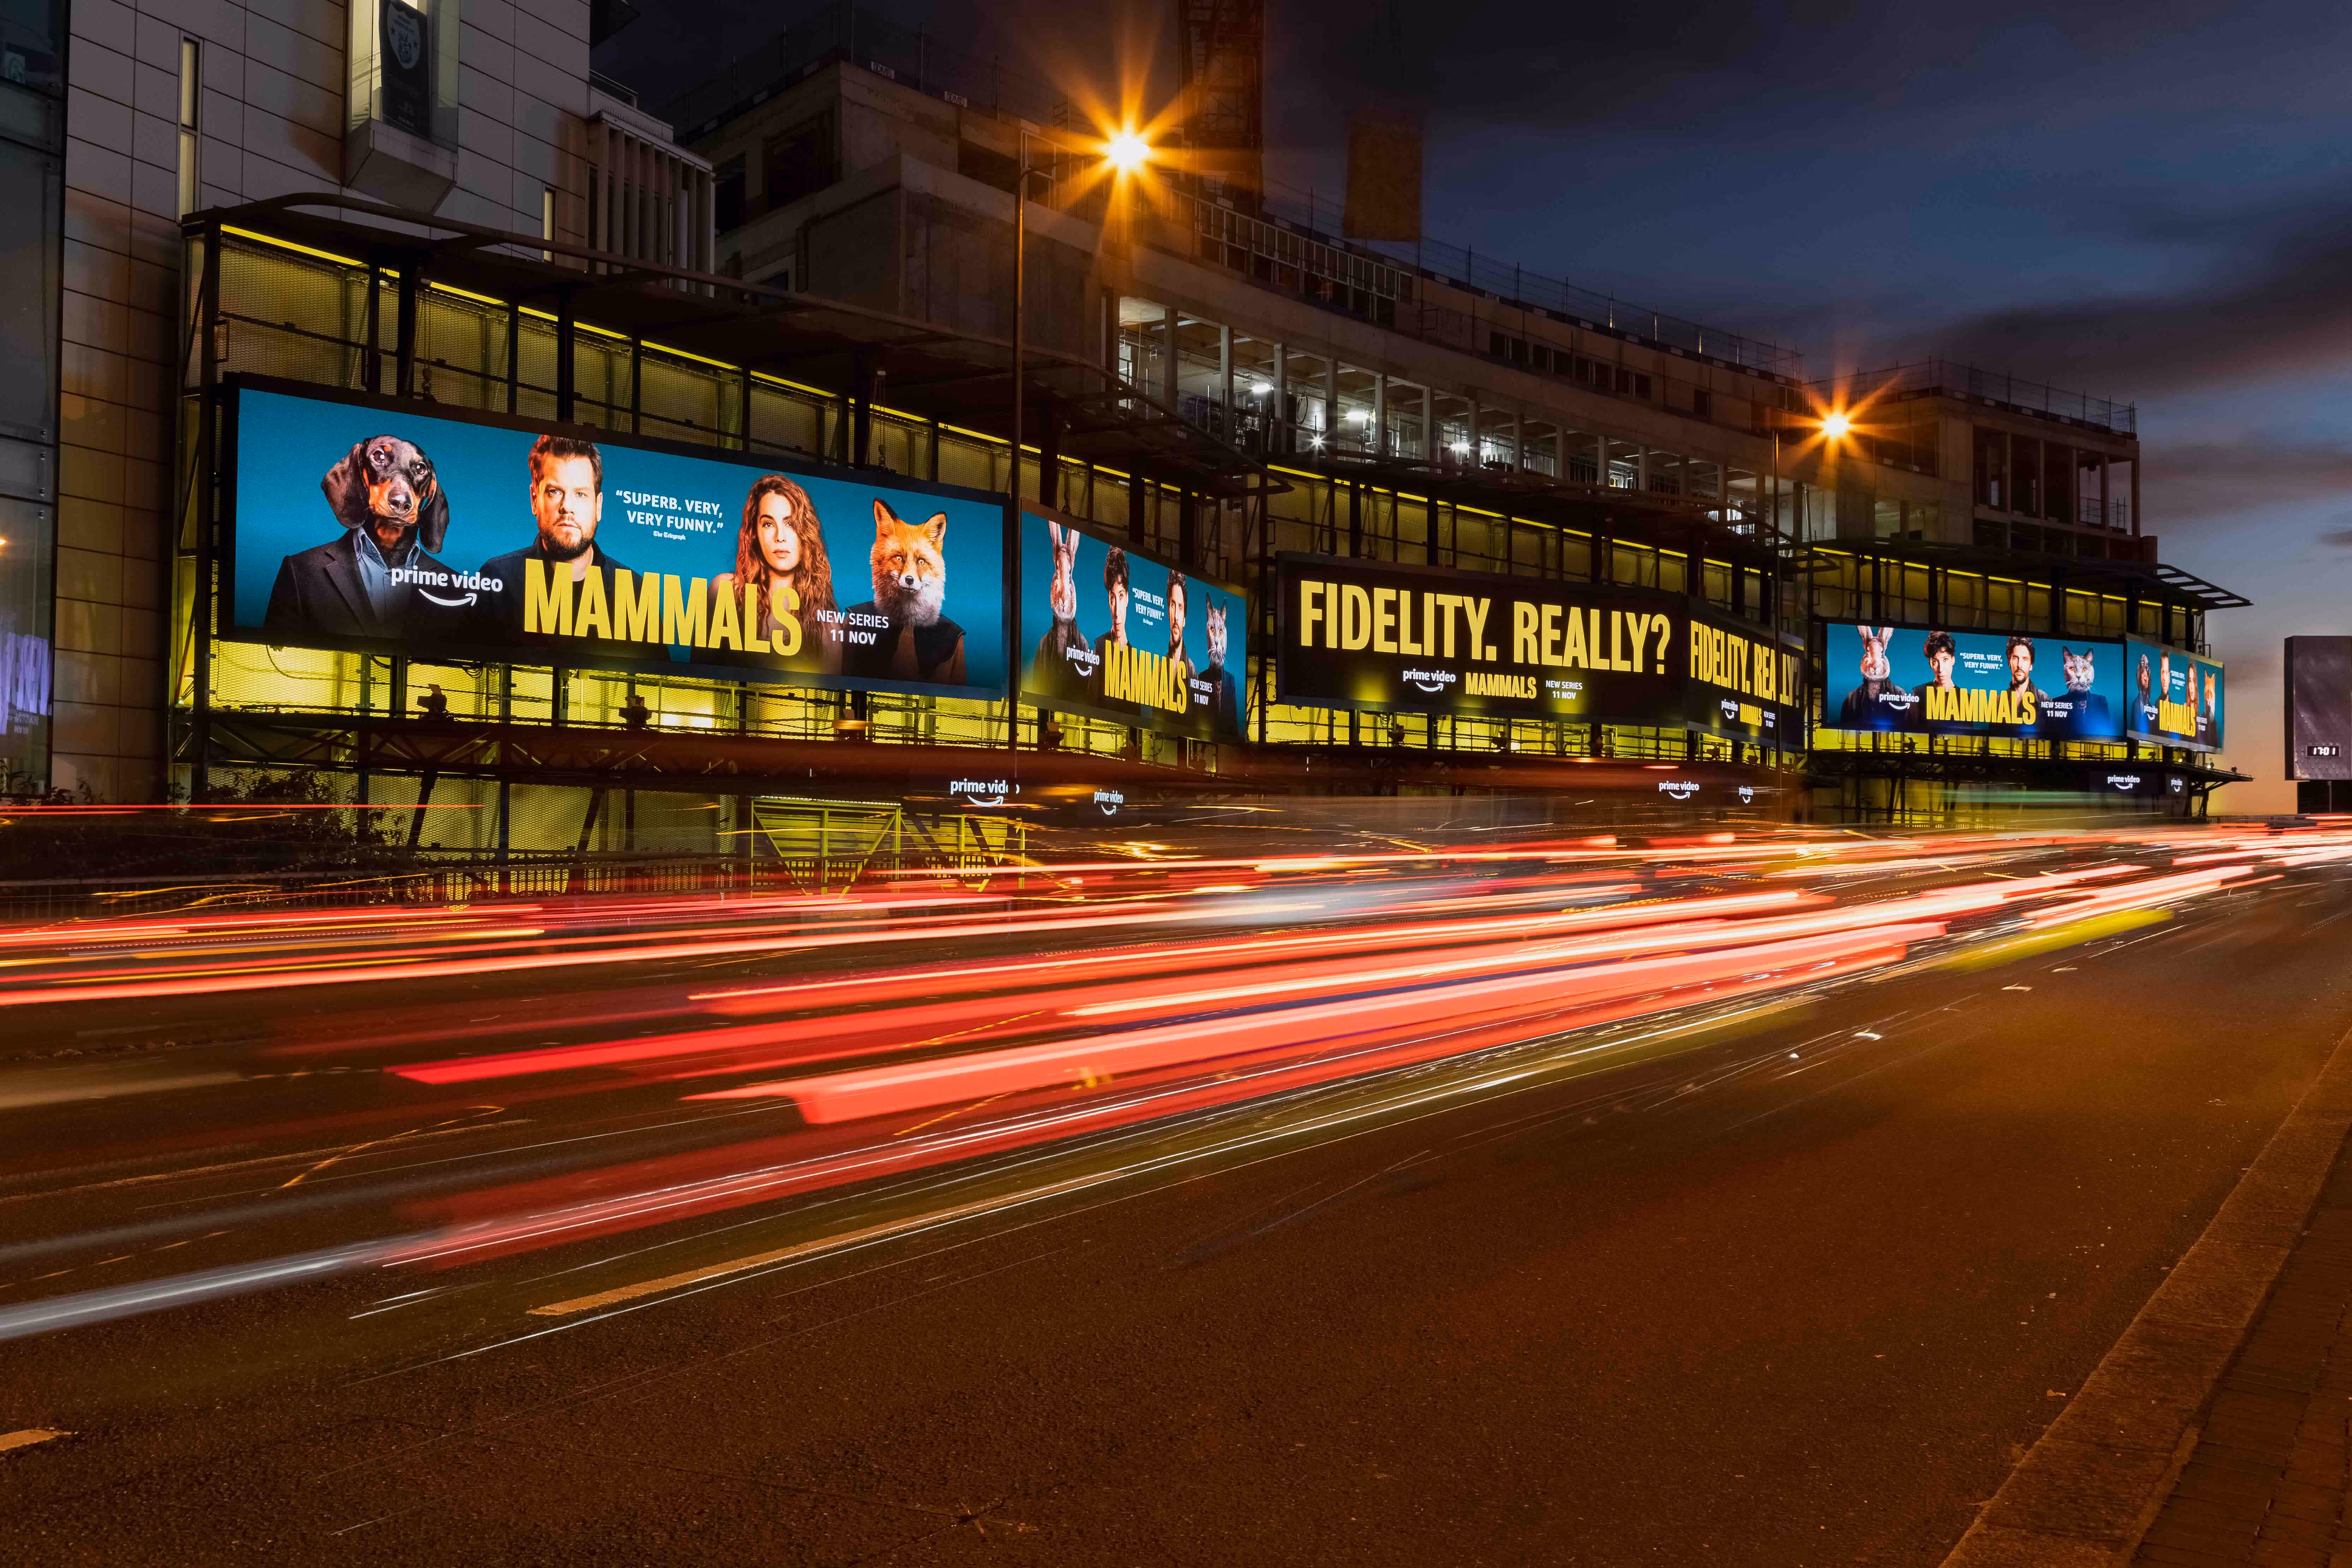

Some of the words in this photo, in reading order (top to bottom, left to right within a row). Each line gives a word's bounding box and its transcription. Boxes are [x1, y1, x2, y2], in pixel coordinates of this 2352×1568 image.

[616, 489, 682, 511] “SUPERB.
[685, 499, 723, 518] VERY,
[627, 510, 664, 526] VERY
[667, 515, 723, 533] FUNNY.”
[391, 565, 448, 586] prime
[452, 570, 503, 592] video
[524, 558, 802, 656] MAMMALS
[1135, 602, 1147, 615] VERY
[1152, 594, 1164, 609] VERY,
[817, 609, 845, 624] NEW
[849, 613, 889, 628] SERIES
[1300, 580, 1497, 661] FIDELITY.
[1514, 601, 1671, 674] REALLY?
[830, 629, 844, 642] 11
[849, 631, 876, 645] NOV
[1067, 644, 1084, 661] prime
[1084, 649, 1100, 665] video
[1690, 620, 1750, 694] FIDELITY.
[1987, 654, 2002, 662] VERY,
[1104, 639, 1187, 714] MAMMALS
[1403, 668, 1430, 682] prime
[1431, 670, 1456, 682] video
[1190, 678, 1199, 689] NEW
[1200, 681, 1212, 693] SERIES
[1465, 672, 1537, 699] MAMMALS
[1546, 680, 1560, 688] NEW
[1562, 681, 1583, 690] SERIES
[1194, 693, 1199, 703] 11
[1200, 694, 1209, 705] NOV
[1562, 691, 1576, 699] NOV
[1879, 692, 1900, 702] prime
[1900, 693, 1920, 702] video
[1926, 686, 2036, 725] MAMMALS
[2159, 699, 2196, 737] MAMMALS
[2313, 747, 2336, 755] 17:01
[950, 778, 986, 795] prime
[1659, 781, 1679, 792] prime
[1680, 781, 1699, 791] video
[2107, 775, 2124, 783] prime
[1094, 788, 1109, 804] prime
[1109, 790, 1124, 804] video
